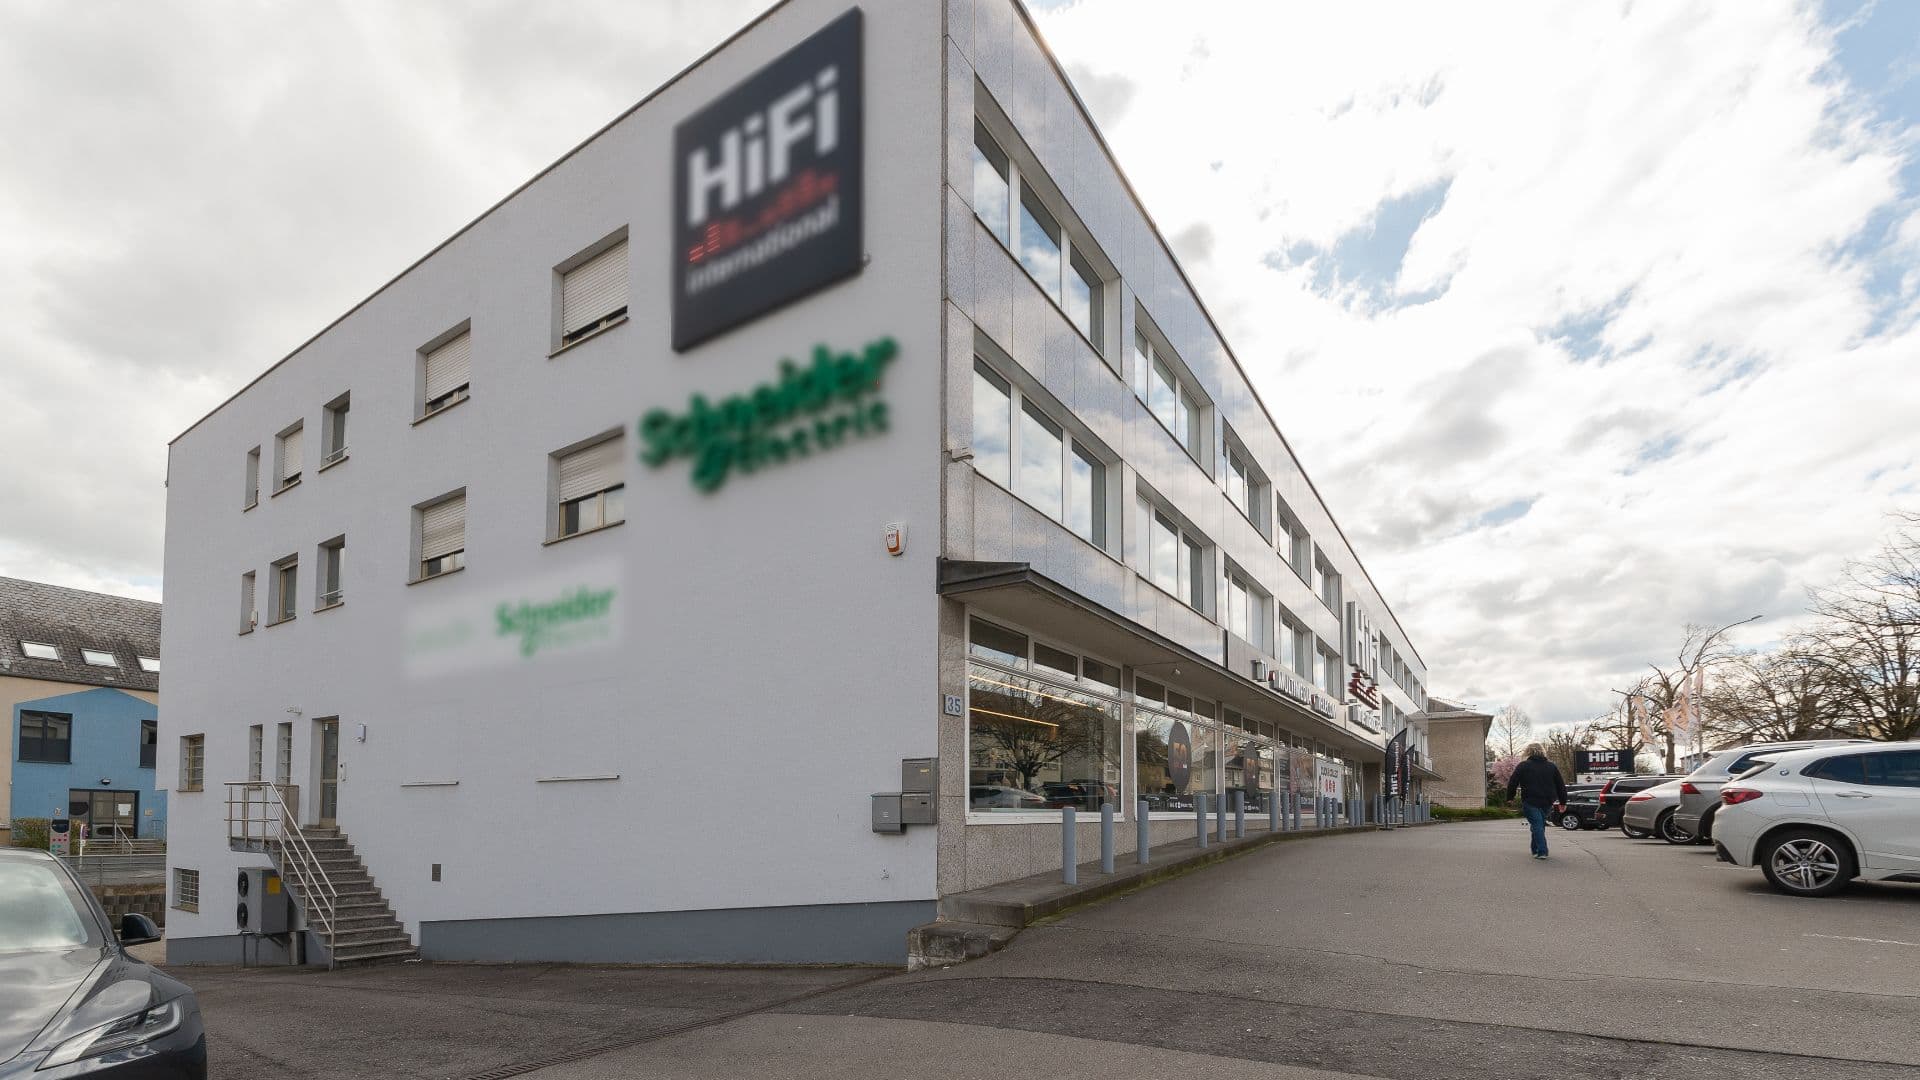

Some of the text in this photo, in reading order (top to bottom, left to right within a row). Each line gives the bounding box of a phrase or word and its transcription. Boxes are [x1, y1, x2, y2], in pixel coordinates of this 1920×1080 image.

[687, 65, 839, 228] HiFi
[685, 194, 839, 294] international
[640, 338, 899, 468] Schneider
[947, 696, 961, 713] 35
[1588, 751, 1619, 763] HiFi
